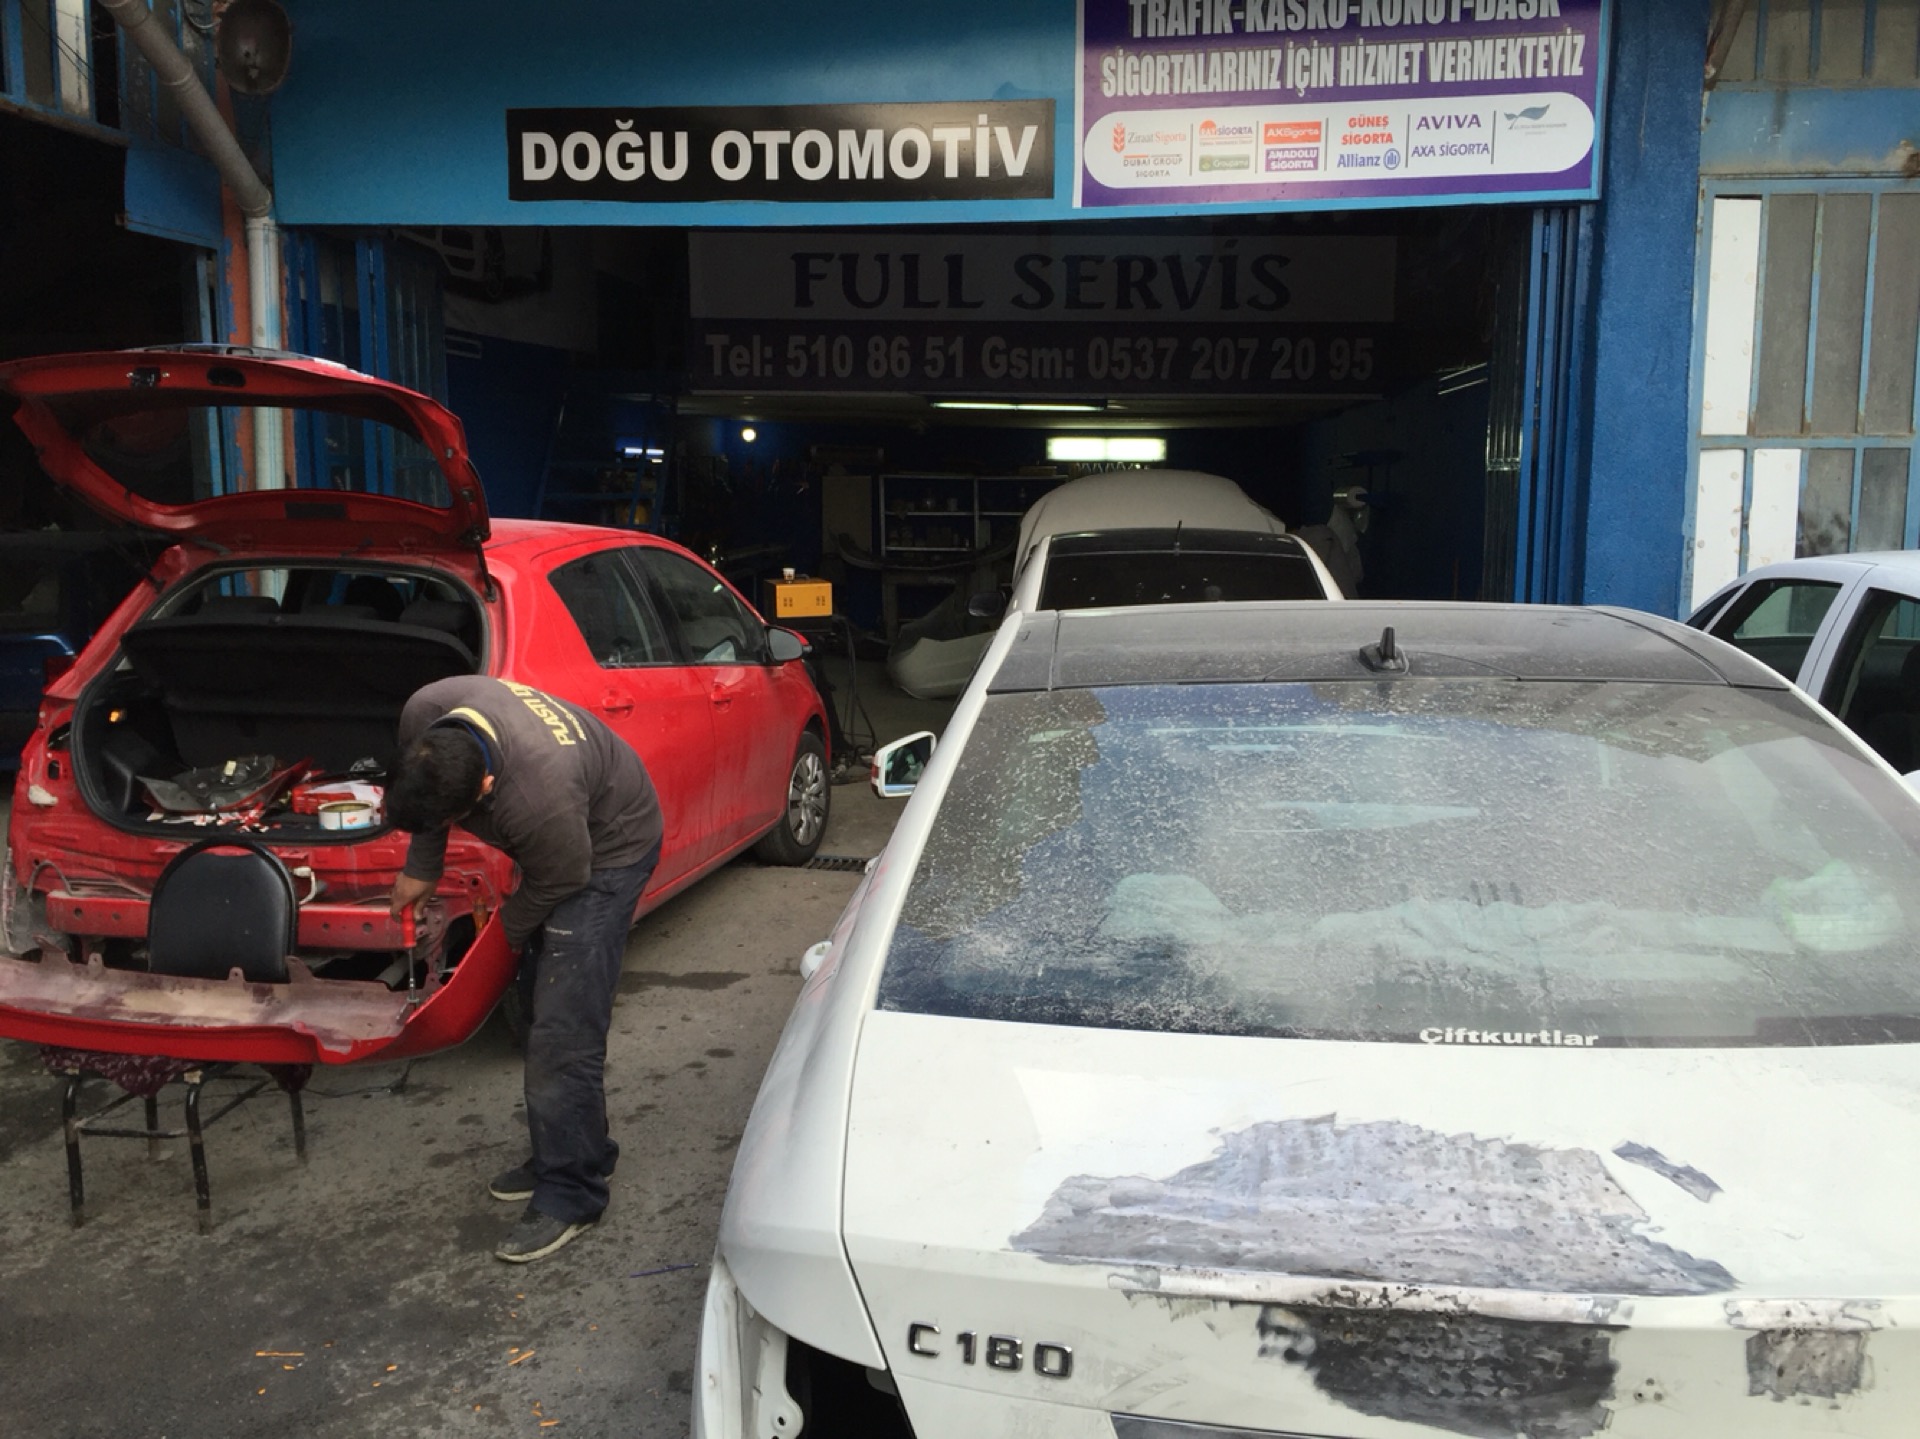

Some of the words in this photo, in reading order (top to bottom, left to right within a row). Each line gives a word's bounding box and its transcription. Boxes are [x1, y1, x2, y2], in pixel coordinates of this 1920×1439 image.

[1102, 47, 1282, 97] SİGORTALARINIZ
[1286, 40, 1335, 97] İÇİN
[1340, 37, 1424, 86] HİZMET
[1428, 27, 1586, 82] VERMEKTEYİZ
[1416, 114, 1482, 131] AVIVA
[522, 119, 689, 182] DOĞU
[711, 113, 1039, 181] OTOMOTİV
[1268, 149, 1318, 159] ANADOLU
[1337, 152, 1381, 168] Allianz
[1411, 146, 1436, 157] AXA
[790, 252, 985, 310] FULL
[1011, 239, 1293, 312] SERVİS
[706, 335, 773, 378] Tel:
[787, 335, 854, 379] 510
[866, 335, 911, 379] 86
[924, 336, 965, 379] 51
[981, 335, 1075, 379] Gsm:
[1087, 337, 1179, 380] 0537
[1191, 337, 1259, 381] 207
[1271, 337, 1316, 381] 20
[1328, 337, 1374, 381] 95
[1419, 1027, 1599, 1047] Çiftkurtlar
[908, 1321, 941, 1359] C
[956, 1329, 1073, 1380] 180
